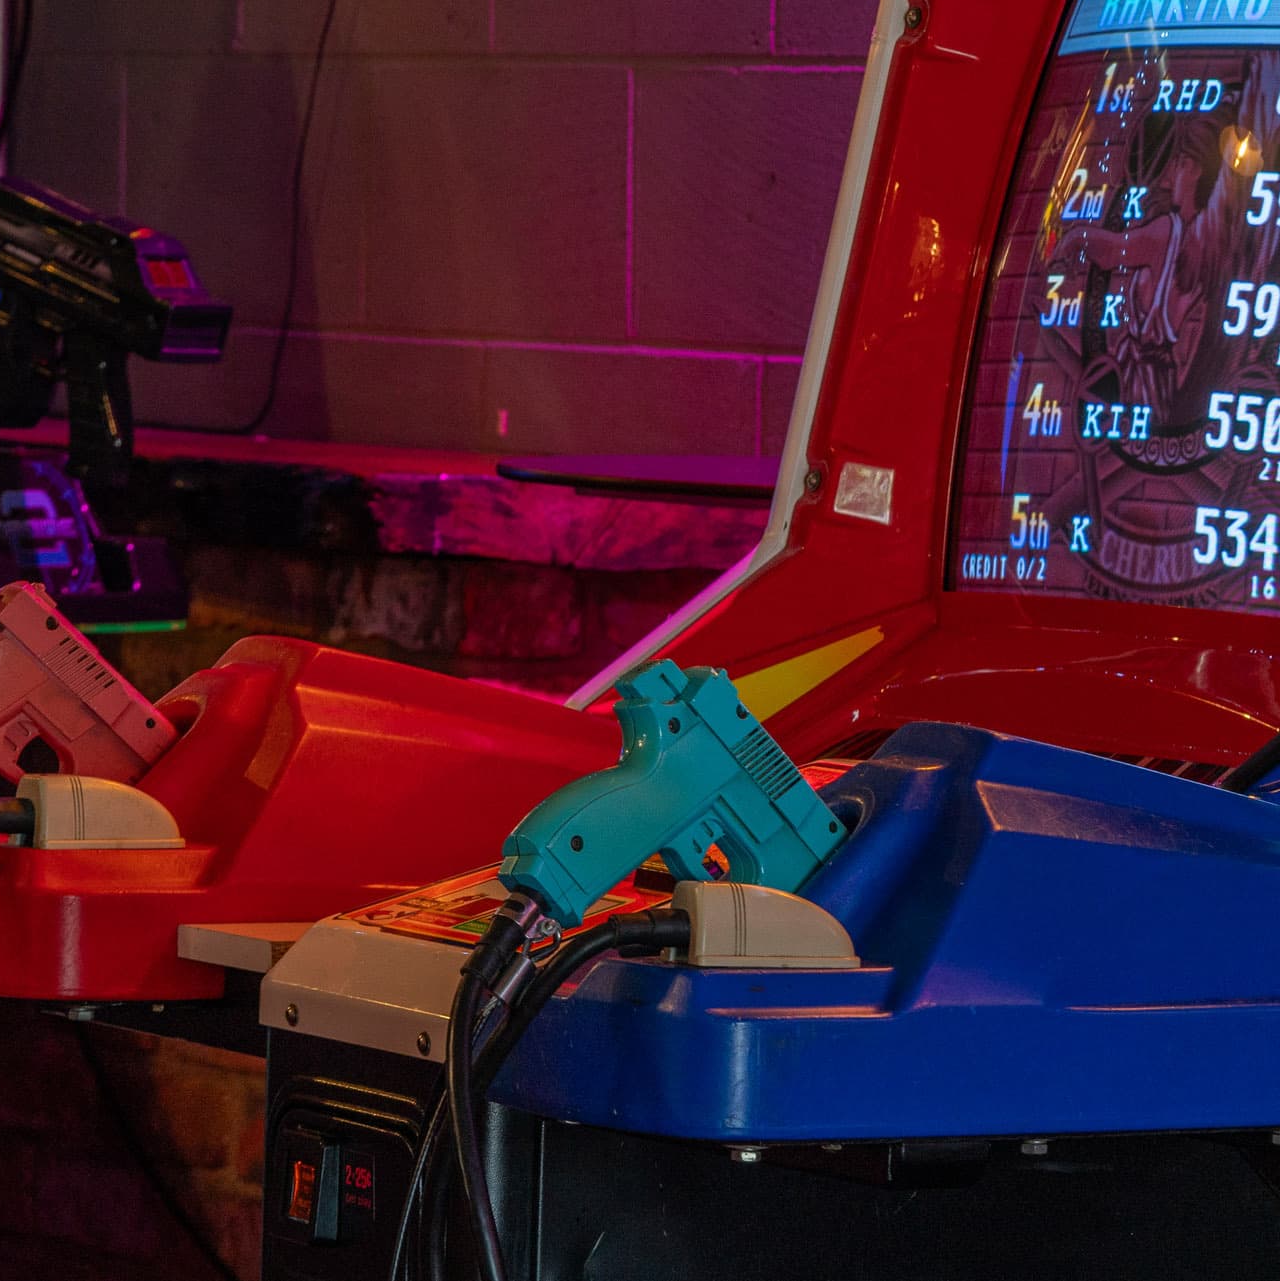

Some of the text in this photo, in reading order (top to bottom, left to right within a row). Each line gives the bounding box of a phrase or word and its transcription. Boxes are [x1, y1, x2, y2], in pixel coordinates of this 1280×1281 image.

[1096, 61, 1136, 114] 1st
[1152, 78, 1222, 113] RHD
[1060, 168, 1108, 222] 2nd
[1123, 185, 1148, 220] K
[1040, 273, 1083, 328] 3rd
[1100, 293, 1123, 328] K
[1022, 381, 1062, 439] 4th
[1082, 403, 1152, 442] KIH
[1009, 493, 1050, 553] 5th
[1070, 515, 1092, 554] K
[962, 554, 1008, 582] CREDIT
